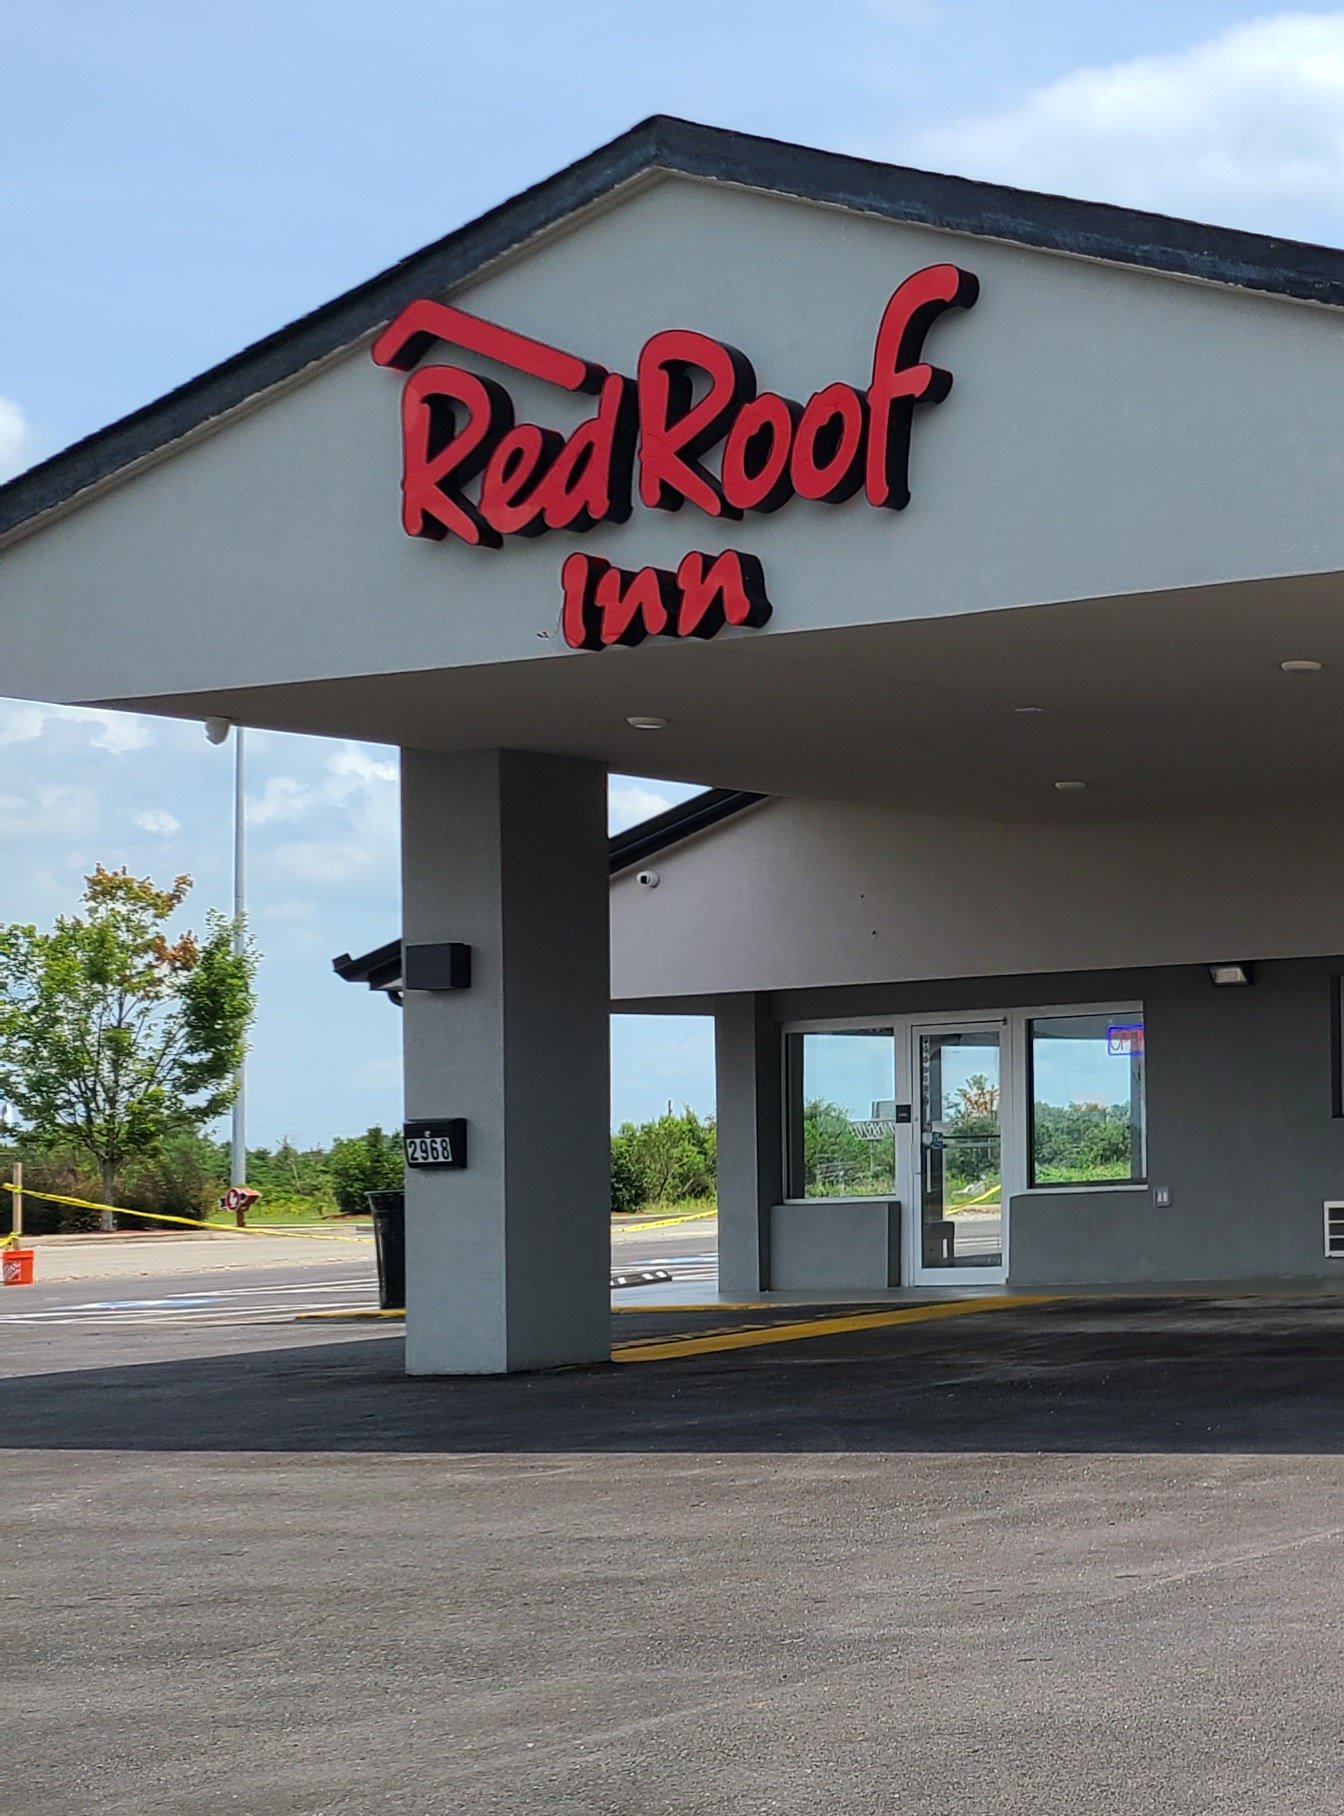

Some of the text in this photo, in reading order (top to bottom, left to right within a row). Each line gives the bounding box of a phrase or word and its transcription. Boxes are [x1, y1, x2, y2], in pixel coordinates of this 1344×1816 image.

[402, 263, 980, 548] Red Roof
[408, 1139, 450, 1161] 2968
